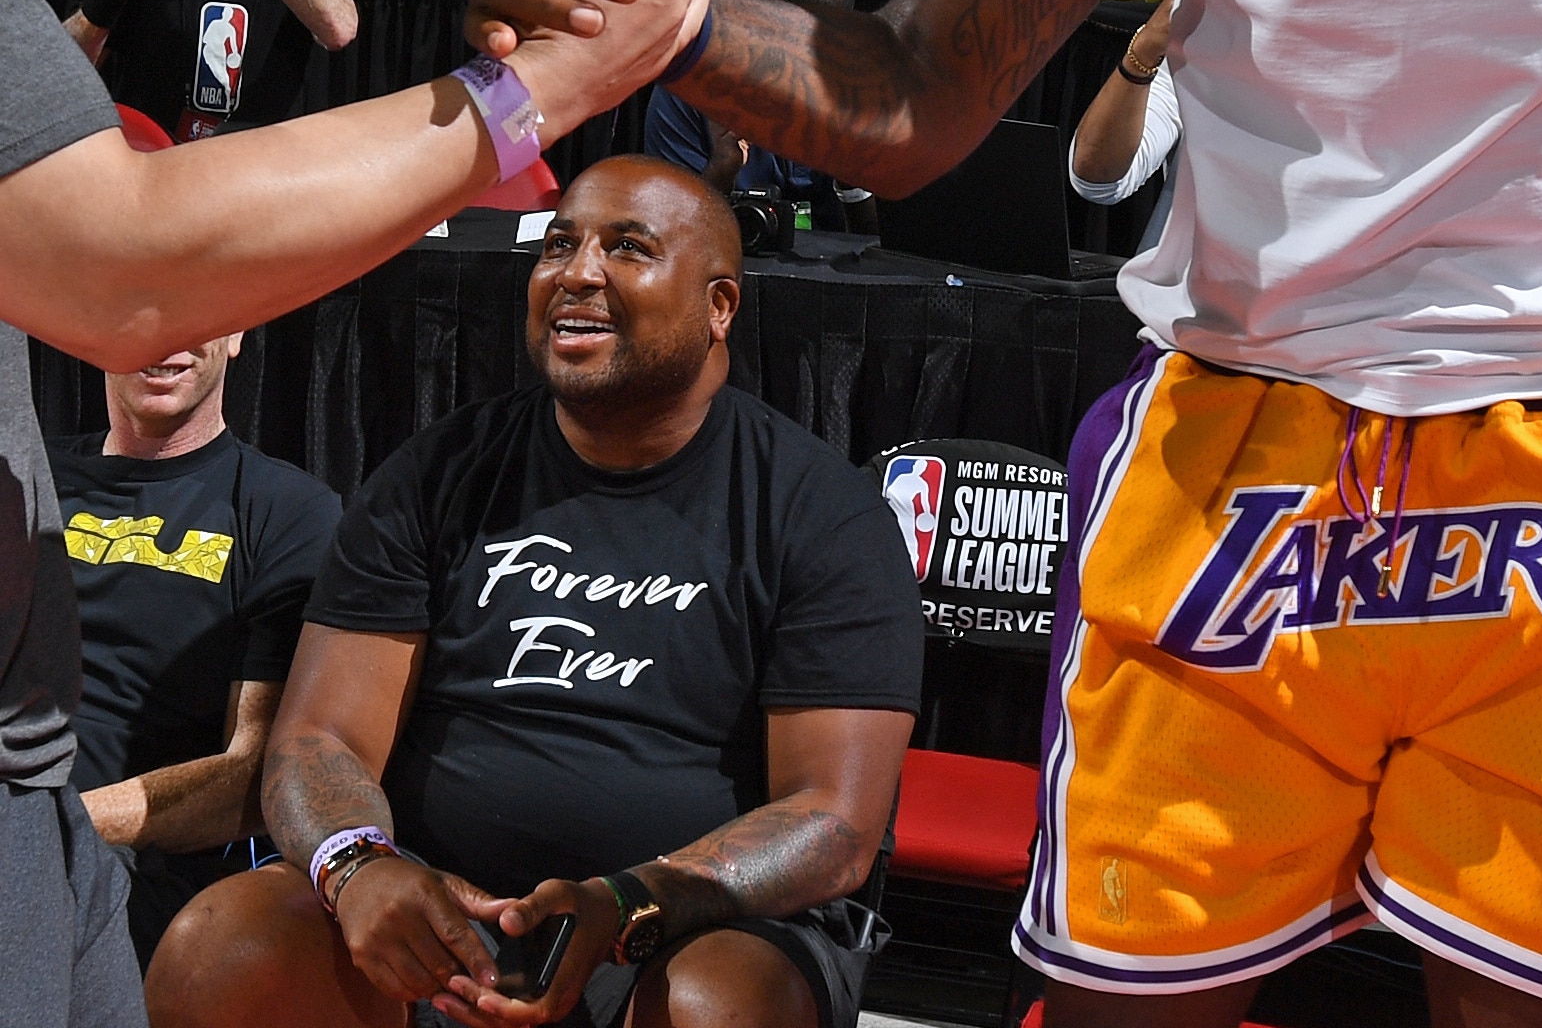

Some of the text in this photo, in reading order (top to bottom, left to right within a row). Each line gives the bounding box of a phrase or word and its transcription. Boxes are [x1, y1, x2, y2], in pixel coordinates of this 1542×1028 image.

[200, 85, 223, 106] NBA
[957, 460, 999, 480] MGM
[477, 534, 709, 611] Forever
[941, 538, 1057, 595] LEAGUE
[492, 616, 655, 689] Ever
